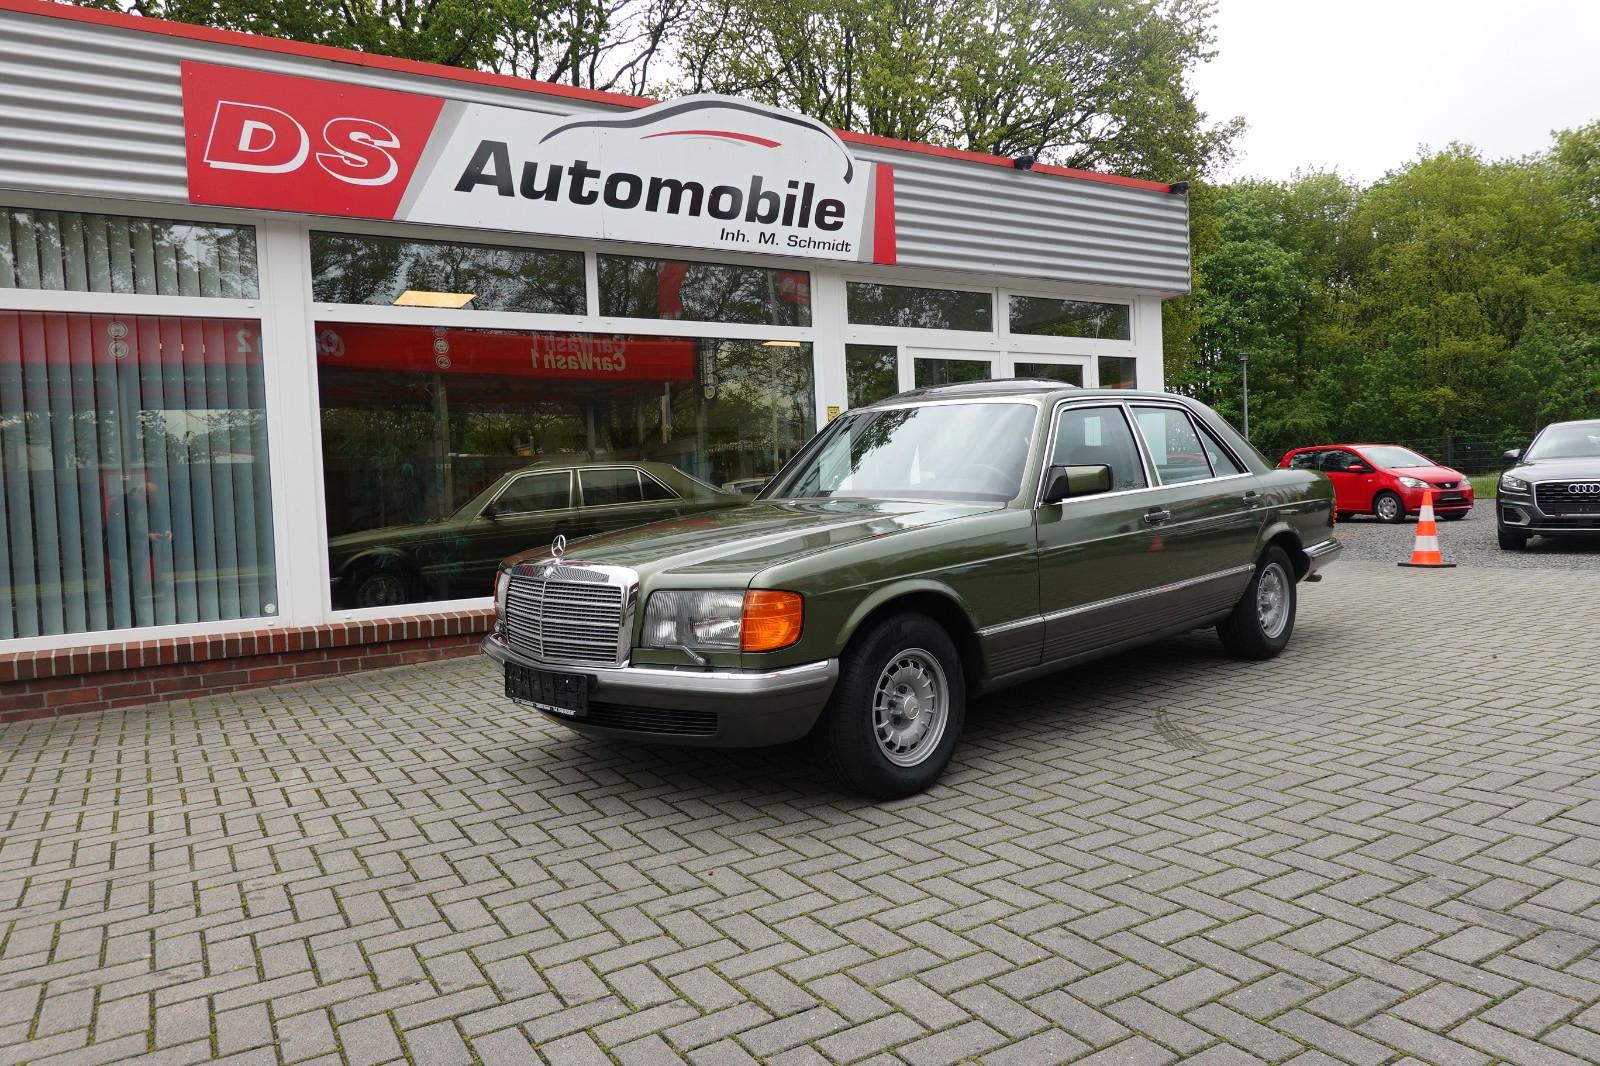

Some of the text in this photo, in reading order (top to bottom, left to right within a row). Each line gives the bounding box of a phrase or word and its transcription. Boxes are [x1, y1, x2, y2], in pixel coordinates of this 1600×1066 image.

[203, 100, 846, 231] DS Automobile
[720, 227, 852, 253] Inh. M. Schmidt
